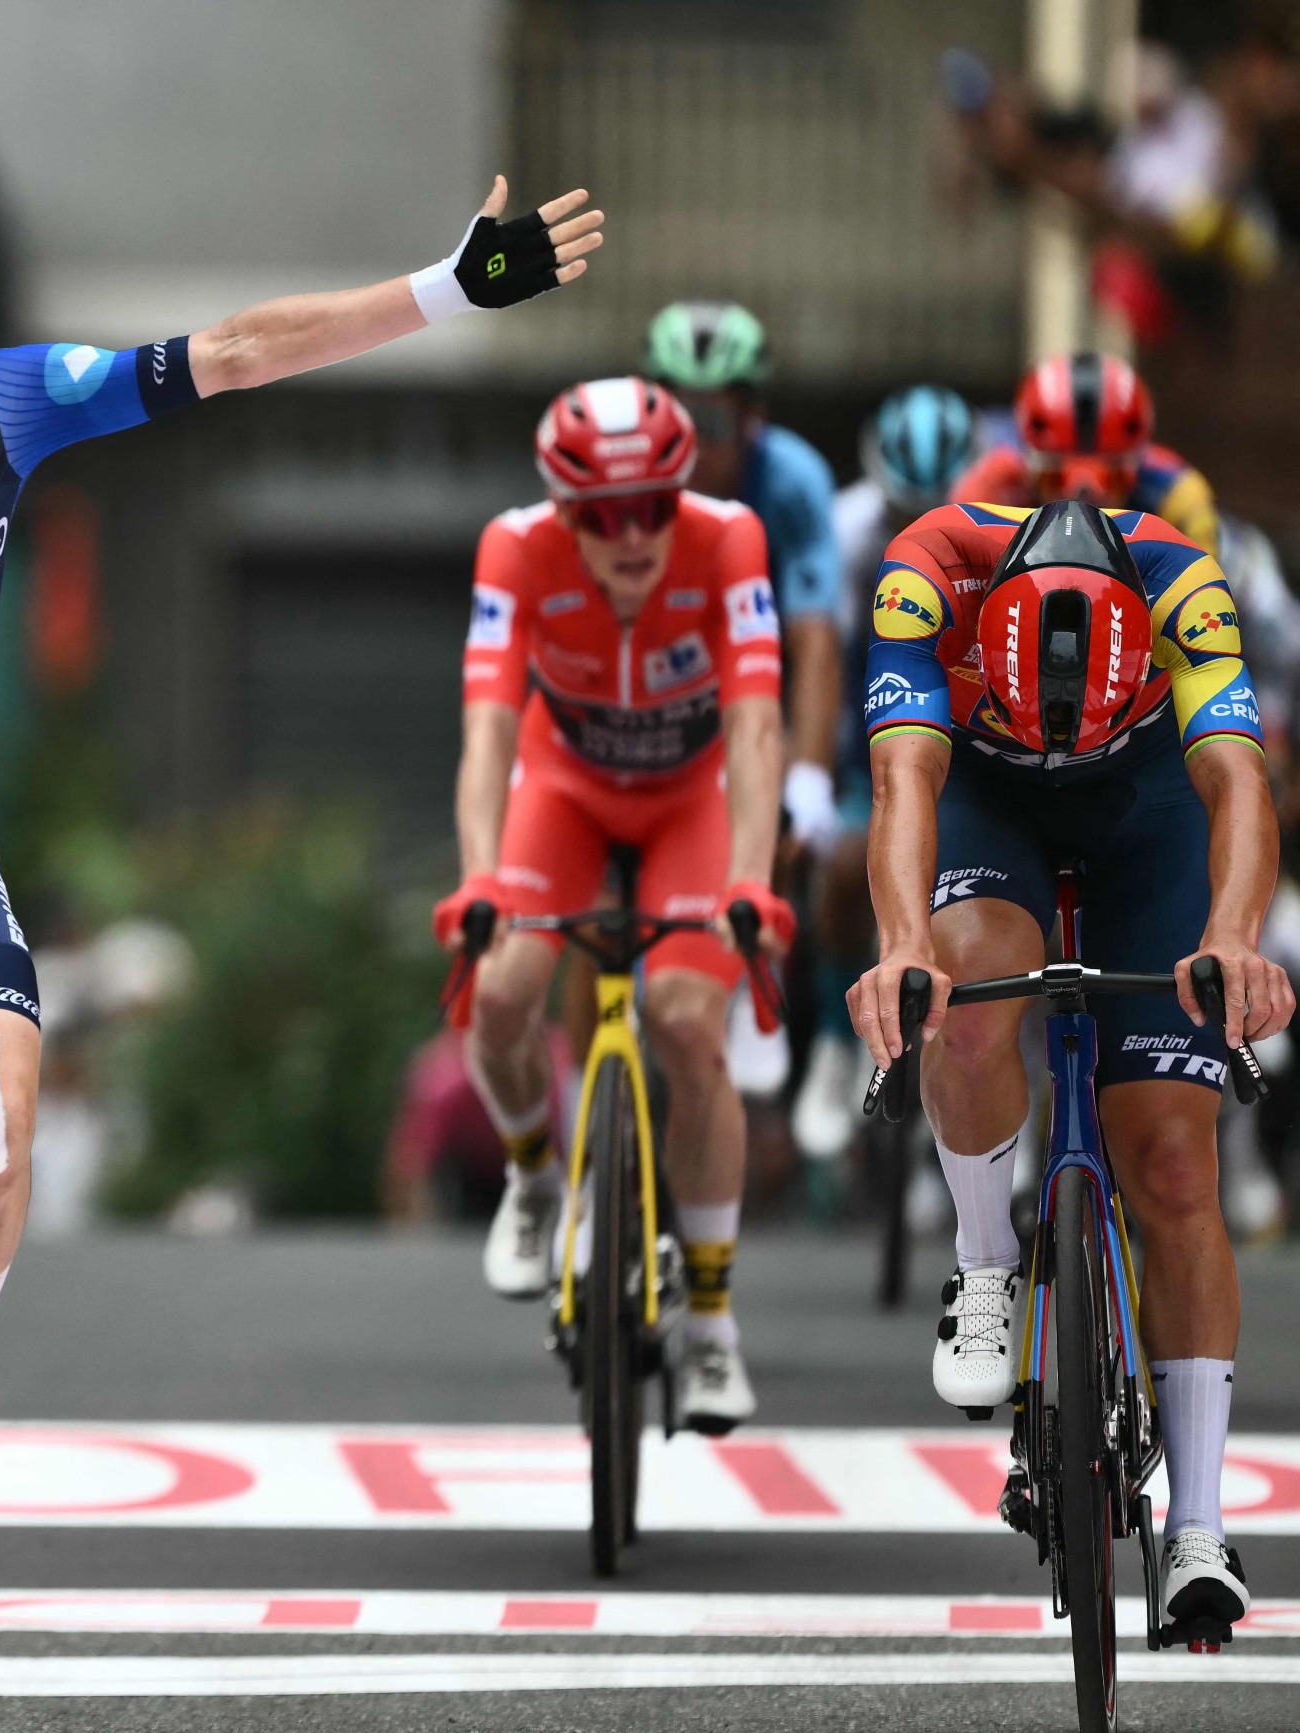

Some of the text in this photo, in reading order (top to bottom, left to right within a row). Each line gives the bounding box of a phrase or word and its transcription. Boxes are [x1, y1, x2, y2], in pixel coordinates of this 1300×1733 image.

[1007, 601, 1021, 704] TREK
[1104, 601, 1123, 705] TREK
[938, 866, 1009, 886] Santini
[1121, 1034, 1193, 1051] Santini
